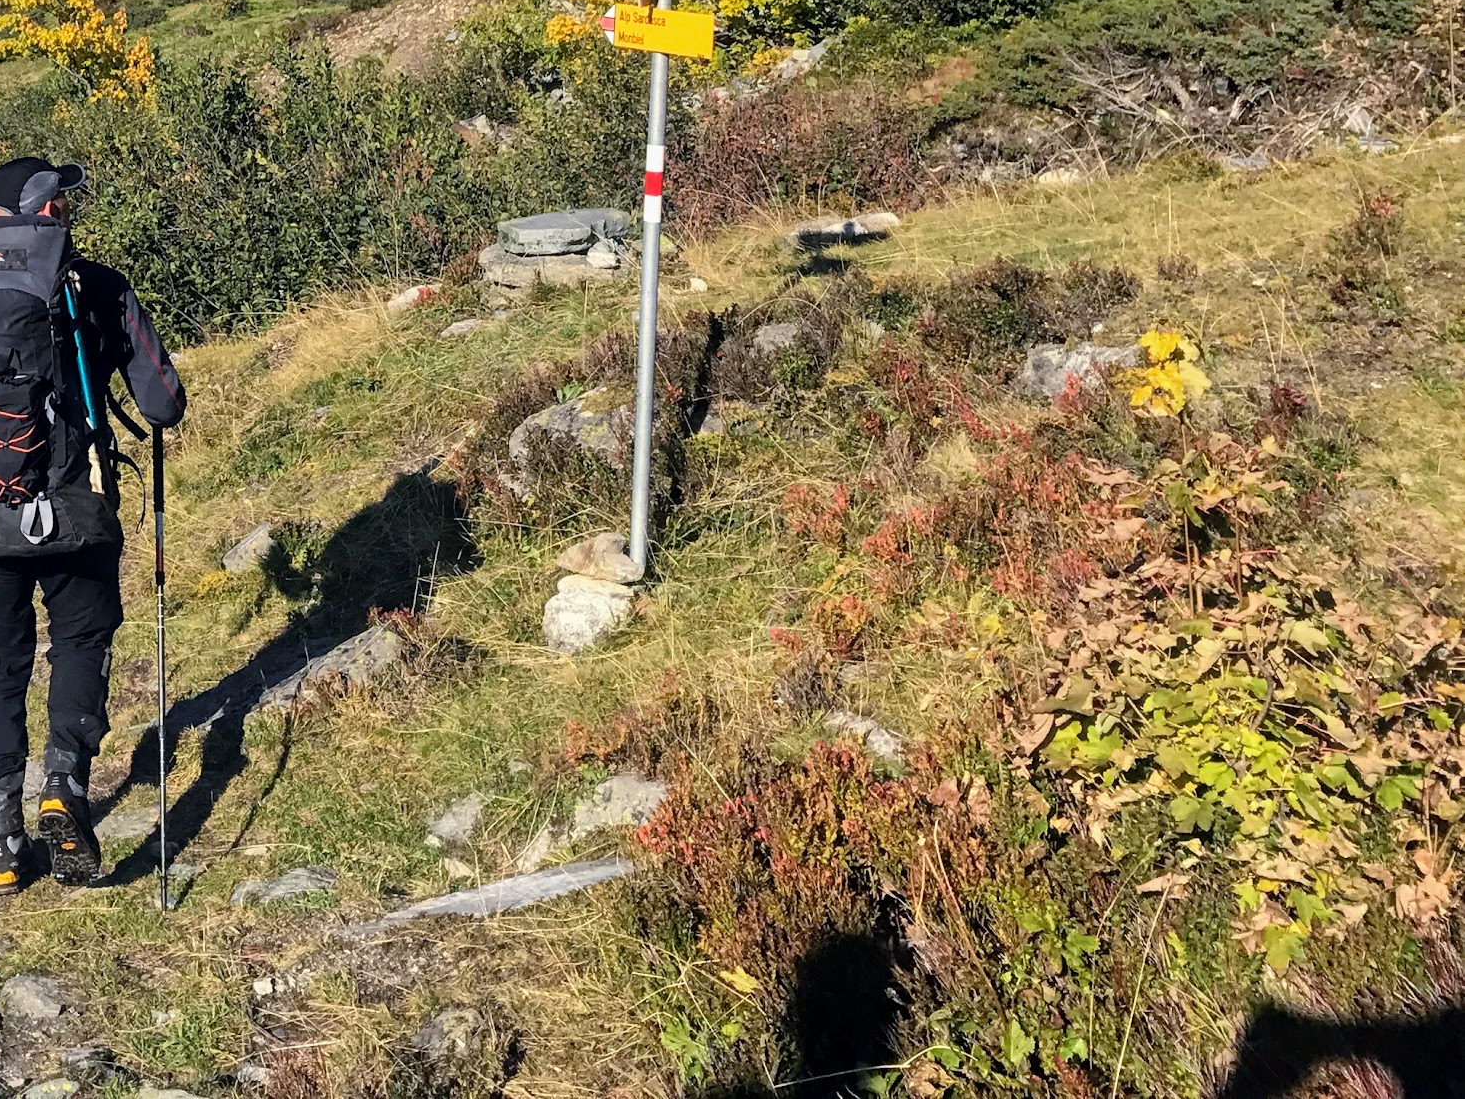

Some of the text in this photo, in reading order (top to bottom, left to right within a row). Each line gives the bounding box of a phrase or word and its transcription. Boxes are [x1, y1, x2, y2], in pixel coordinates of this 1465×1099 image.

[619, 9, 666, 27] Alp Sardsca
[618, 31, 644, 45] Monbiel
